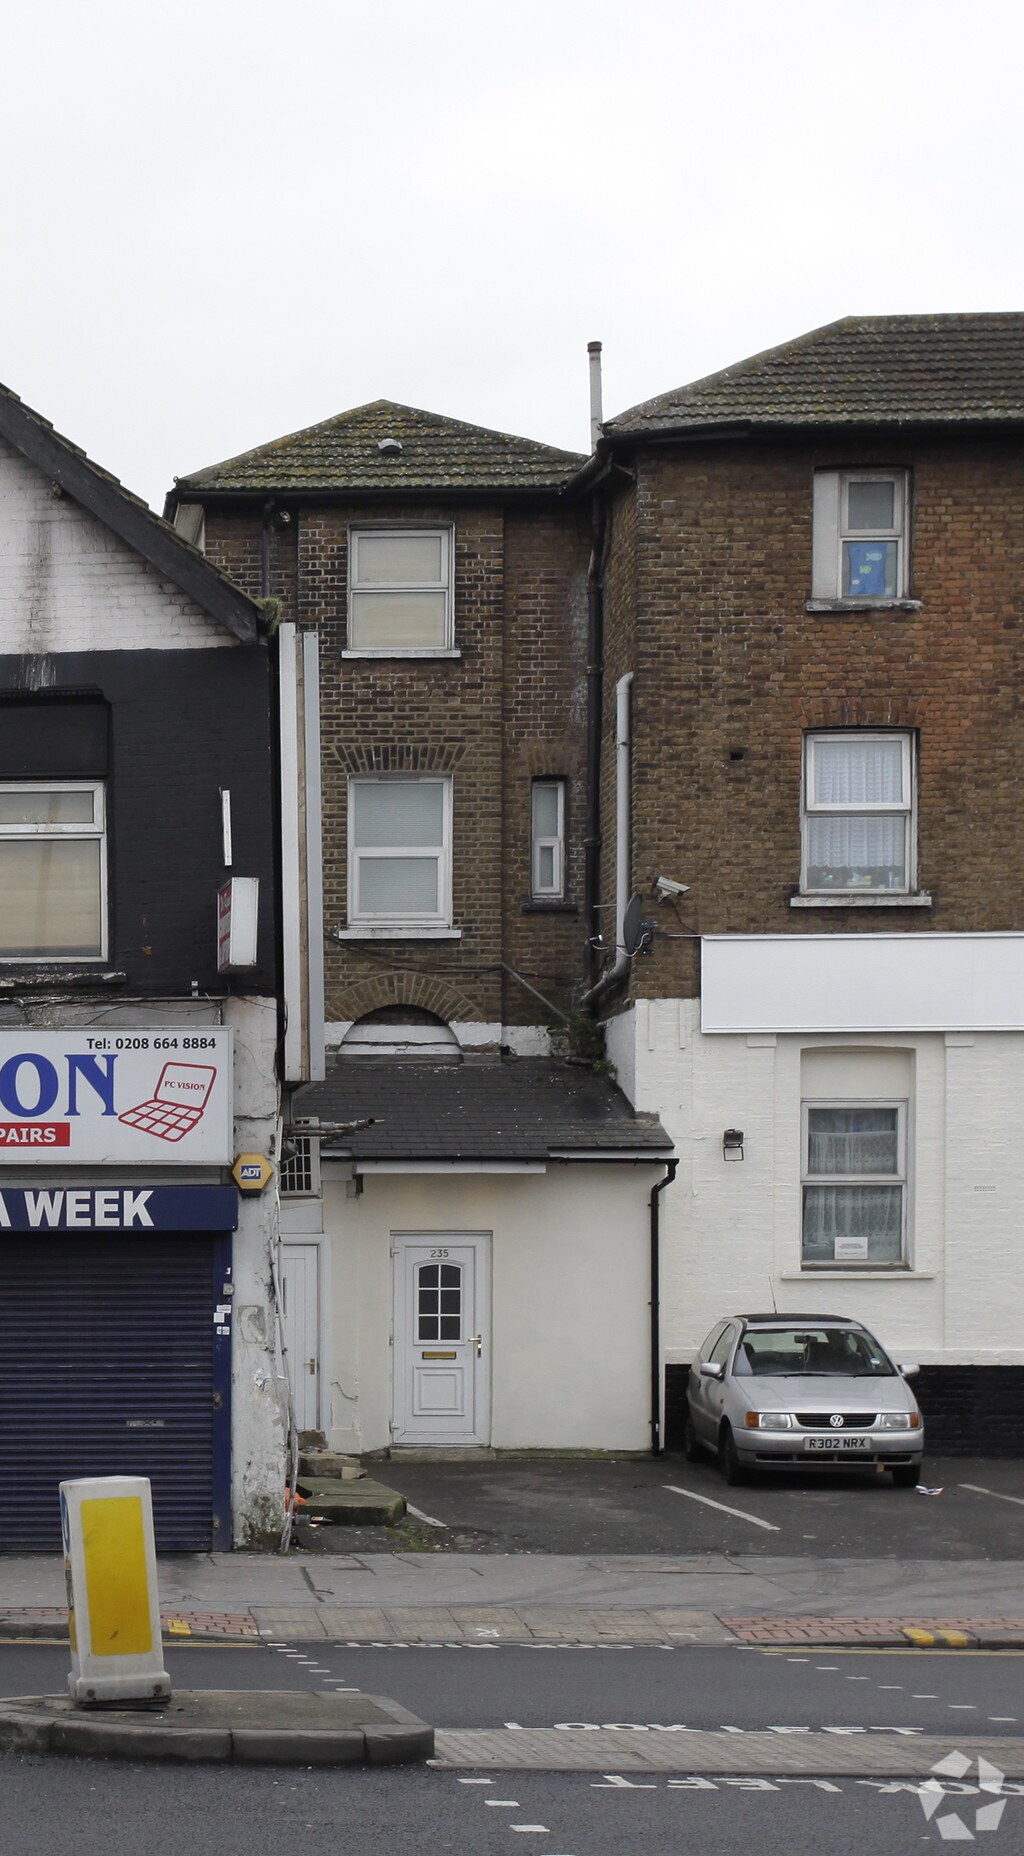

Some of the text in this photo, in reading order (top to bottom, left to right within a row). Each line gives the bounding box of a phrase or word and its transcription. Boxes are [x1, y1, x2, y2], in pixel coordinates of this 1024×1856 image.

[86, 1037, 216, 1049] Tel: 0208 664 8884
[164, 1080, 206, 1091] PC VISION
[241, 1166, 261, 1178] ADT
[24, 1190, 154, 1227] WEEK
[430, 1249, 449, 1258] 235
[809, 1438, 866, 1449] R302 NRX
[503, 1722, 925, 1735] LOOK LEFT
[589, 1774, 843, 1793] LEFT
